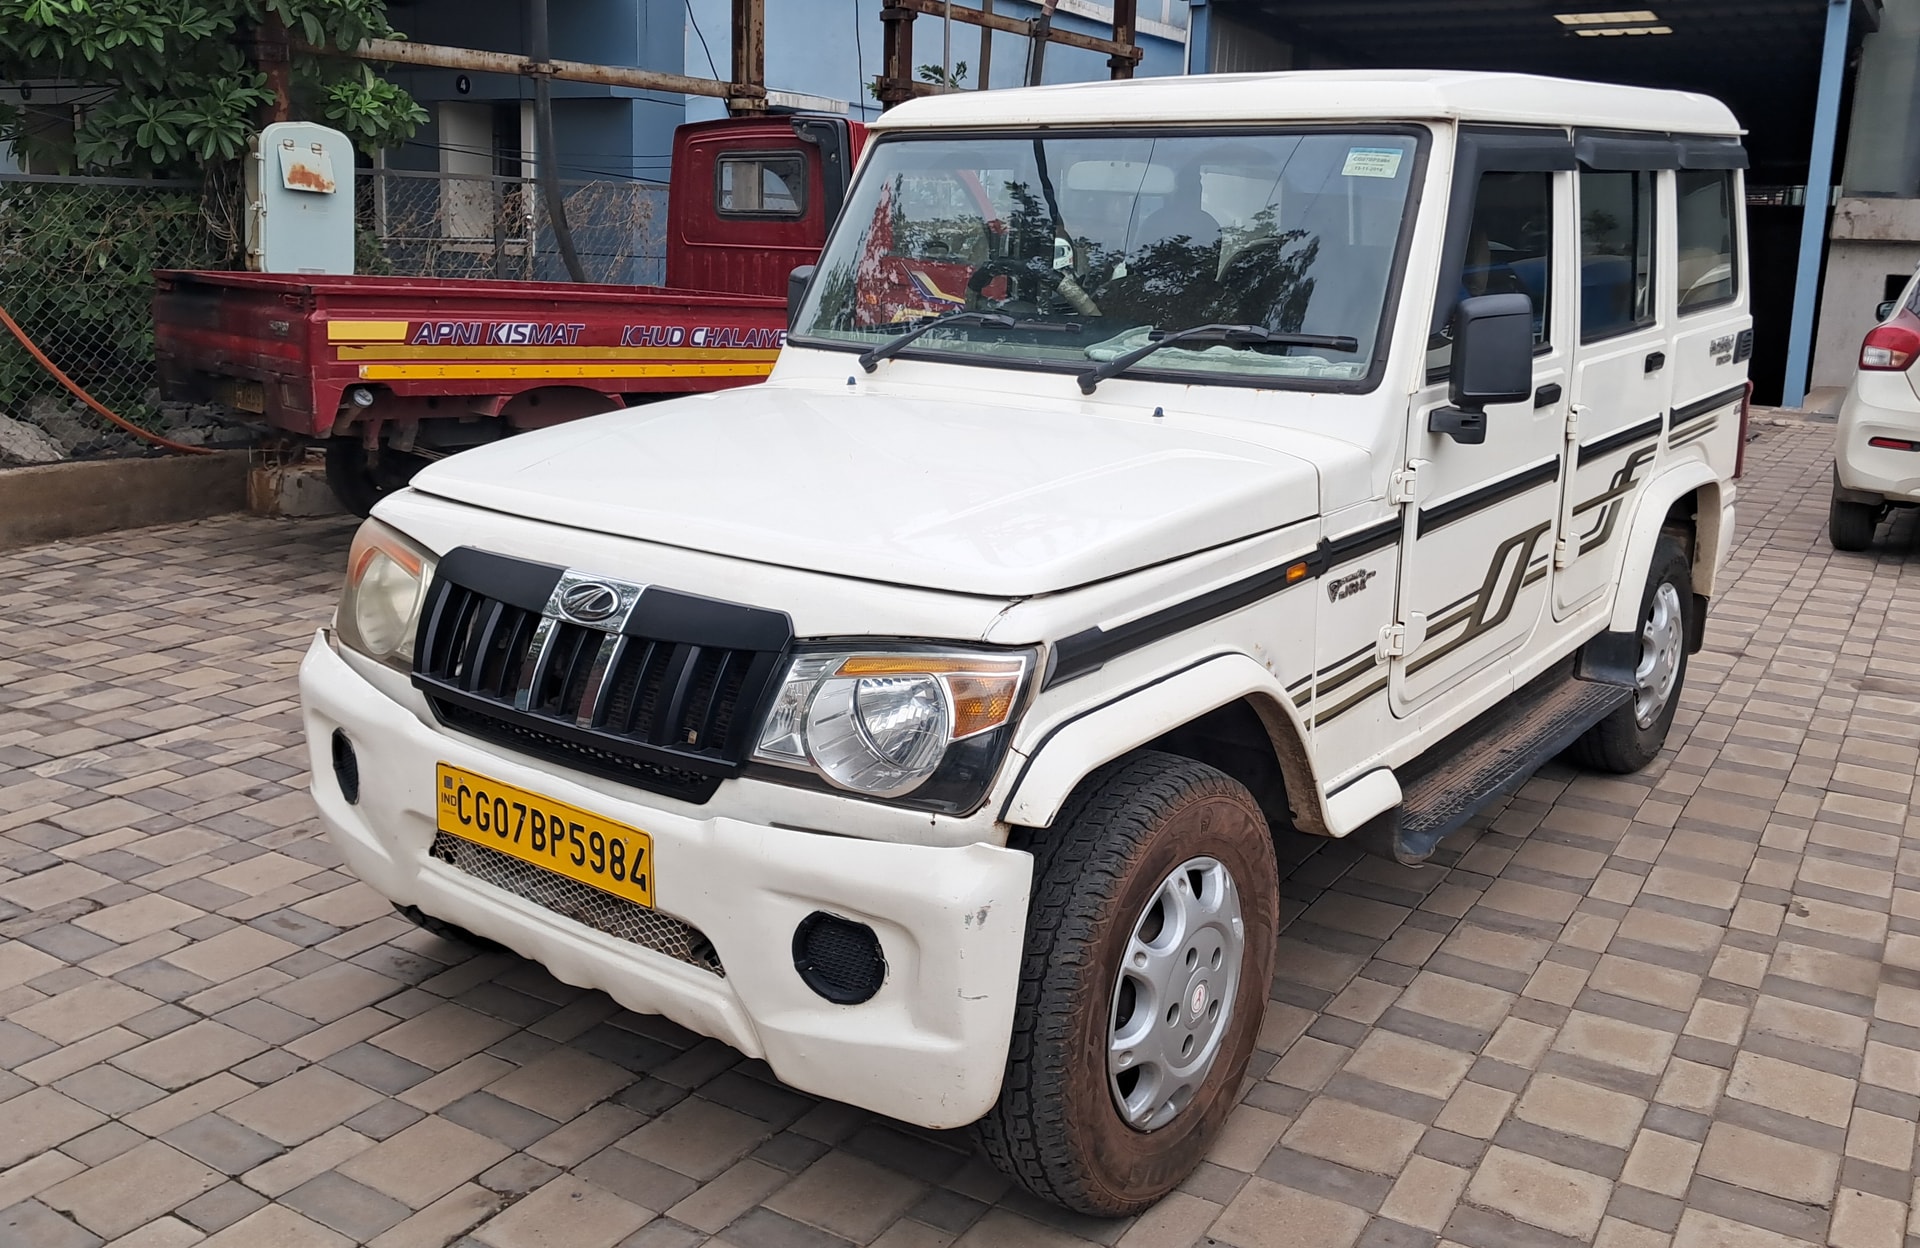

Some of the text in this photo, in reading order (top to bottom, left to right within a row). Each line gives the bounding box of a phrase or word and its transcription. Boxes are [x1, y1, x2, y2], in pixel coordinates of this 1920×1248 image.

[411, 321, 586, 345] APNI KISMAT
[620, 325, 788, 348] KHUD CHALAIYE
[441, 791, 457, 807] IND
[457, 784, 647, 892] CG07BP5984
